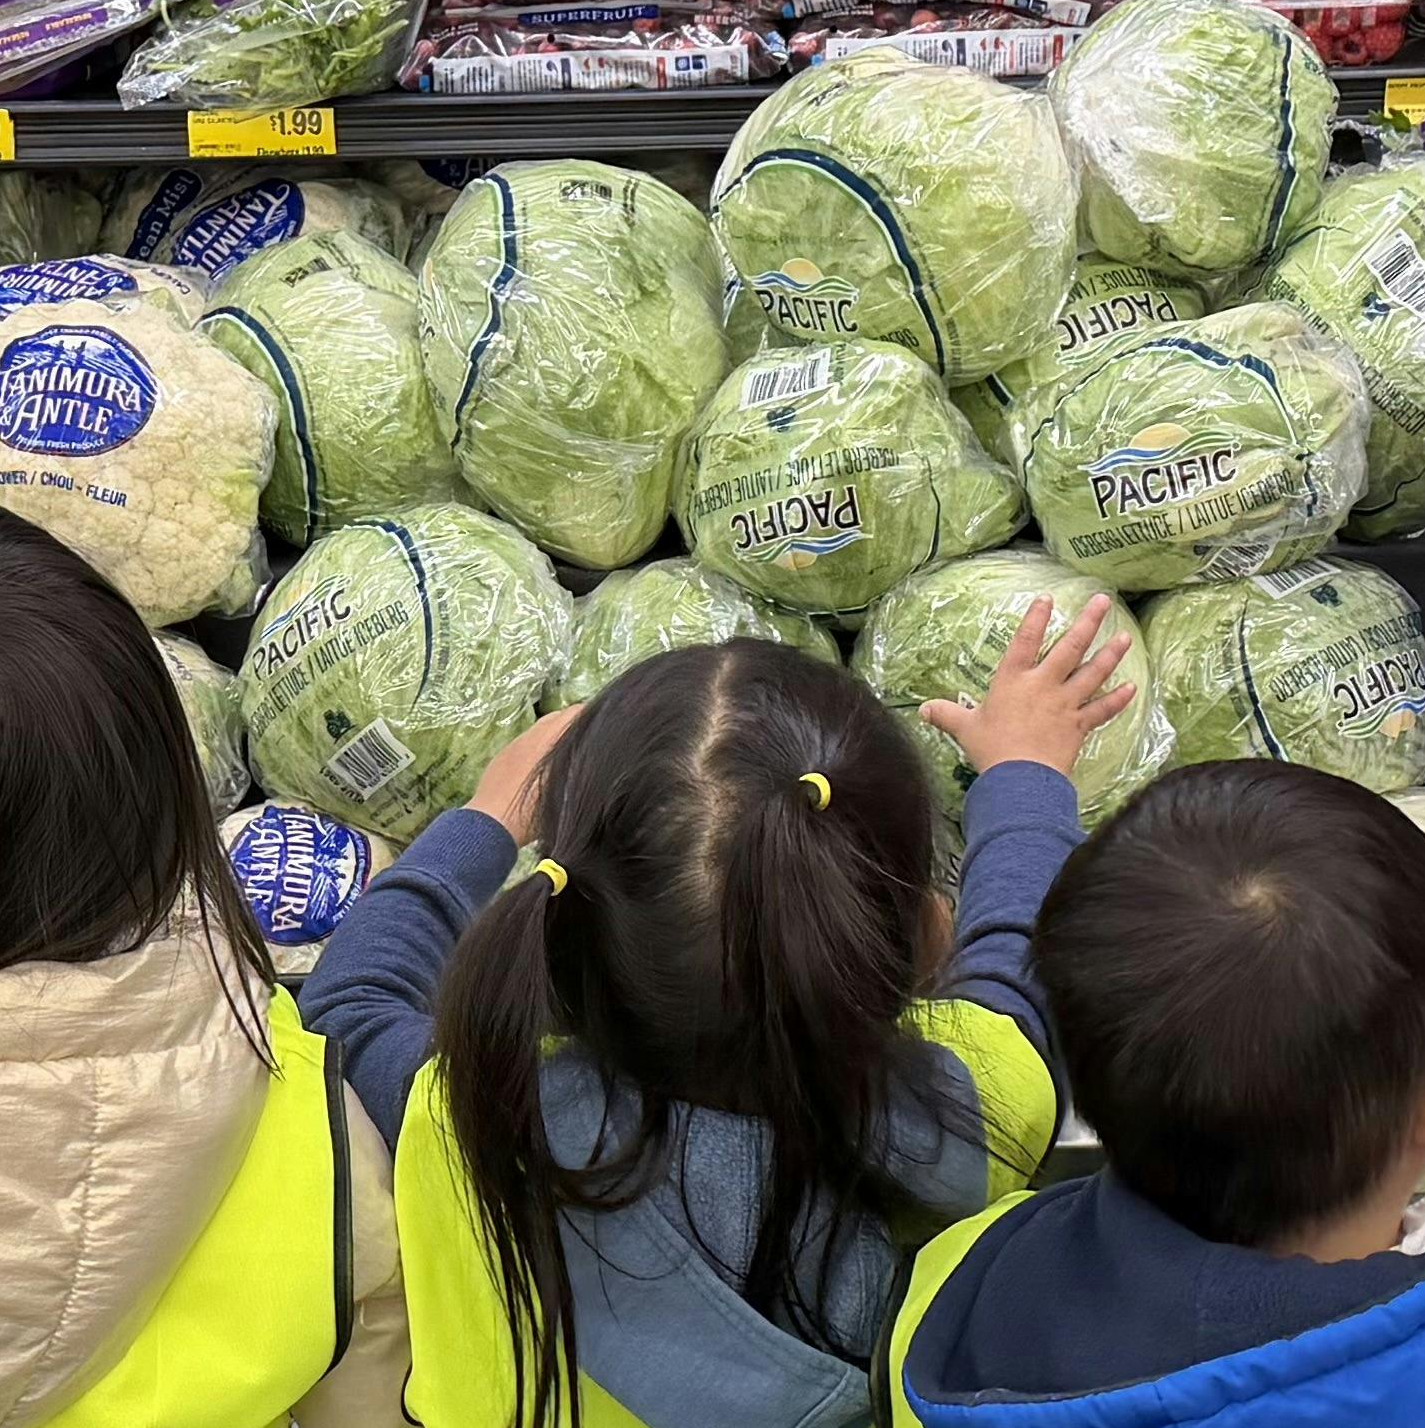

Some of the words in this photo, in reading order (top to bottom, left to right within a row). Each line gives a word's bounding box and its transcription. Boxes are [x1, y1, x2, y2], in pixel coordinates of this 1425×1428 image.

[531, 4, 646, 25] SUPERFRUIT
[270, 109, 323, 136] $1.99
[200, 183, 292, 280] TANIMU
[755, 286, 859, 334] PACIFIC
[1058, 290, 1178, 352] PACIFIC
[13, 393, 114, 438] ANTLE
[40, 472, 74, 493] CHOU
[85, 483, 127, 508] FLEUR
[786, 453, 844, 486] LETTUCE
[1090, 446, 1237, 519] PACIFIC
[730, 484, 861, 549] PACIFIC
[1069, 527, 1121, 561] ICEBERG
[1120, 511, 1173, 545] LETTUCE
[1189, 493, 1238, 532] LAITUE
[253, 587, 352, 683] PACIFIC
[268, 664, 311, 714] LETTUCE
[354, 599, 409, 653] ICEBERG
[242, 818, 281, 908] ANTLE
[271, 811, 316, 934] TANIMURA
